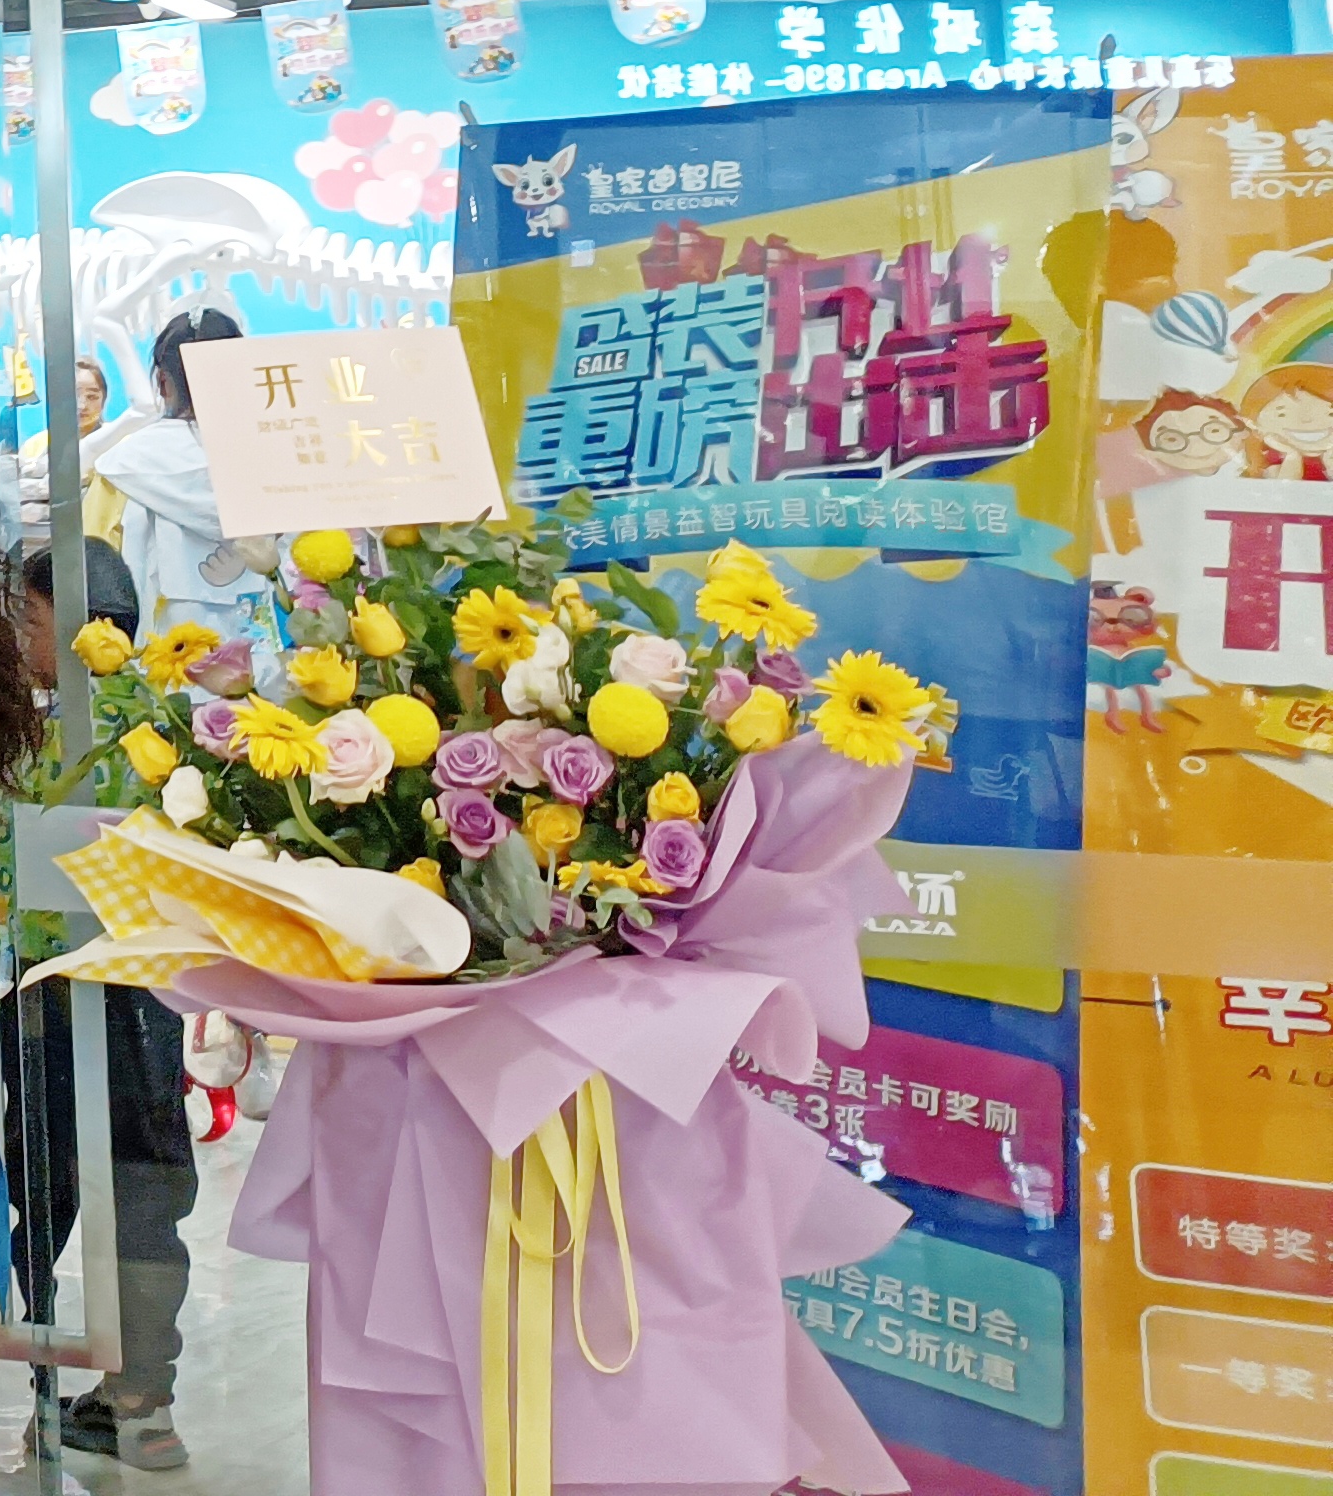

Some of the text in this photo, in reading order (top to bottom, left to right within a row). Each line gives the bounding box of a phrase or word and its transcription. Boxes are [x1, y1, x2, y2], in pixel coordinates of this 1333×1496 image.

[576, 350, 628, 378] SALE
[252, 356, 376, 410] 开业
[334, 416, 441, 467] 大吉
[863, 916, 958, 937] LAZA
[1247, 1064, 1272, 1081] A
